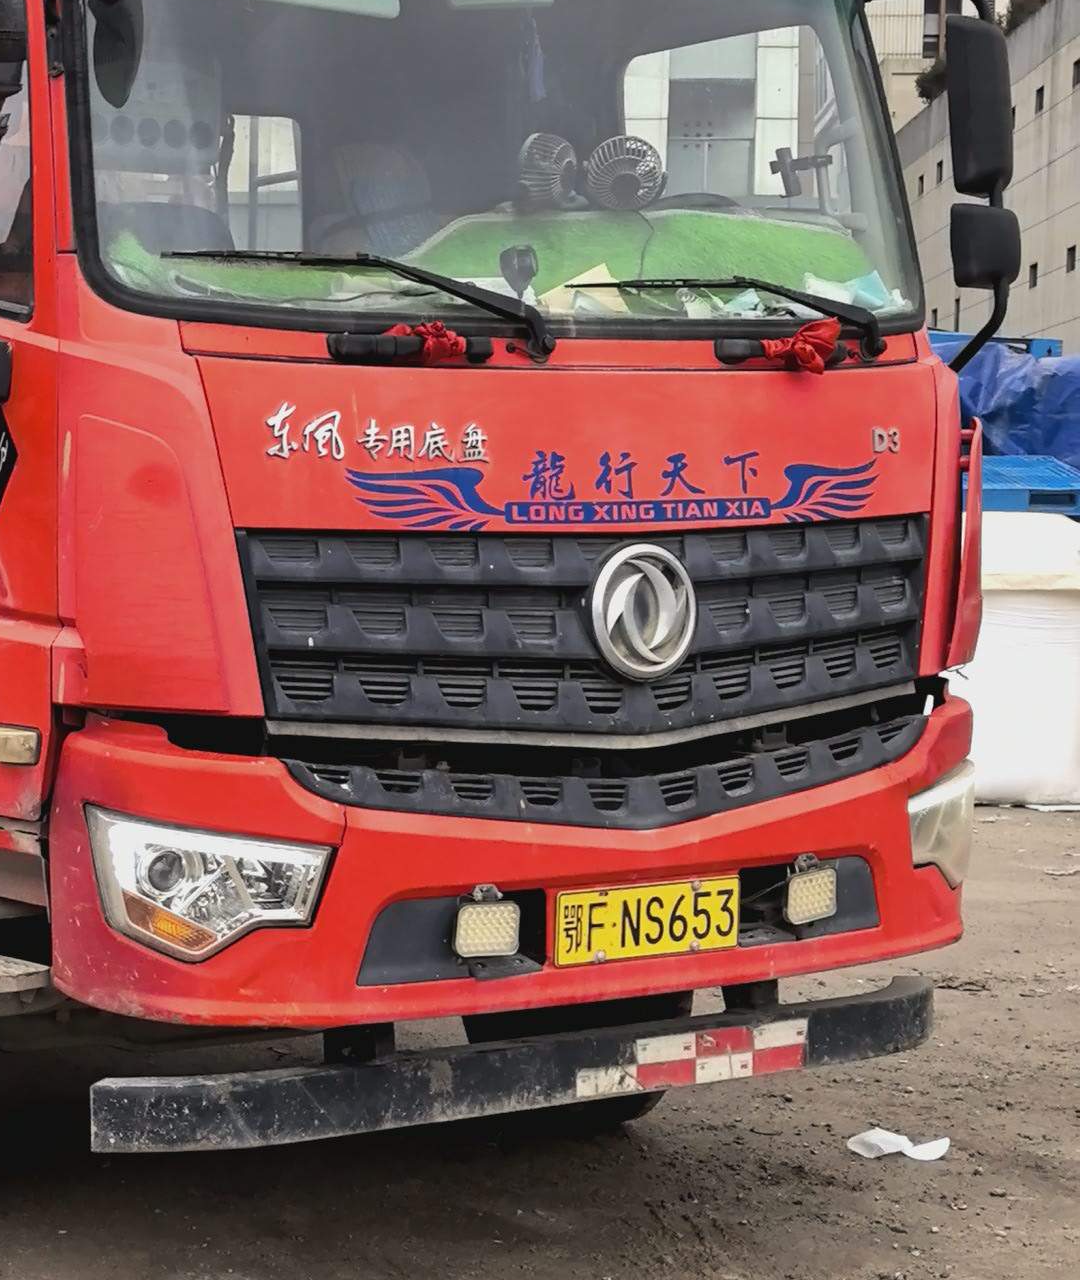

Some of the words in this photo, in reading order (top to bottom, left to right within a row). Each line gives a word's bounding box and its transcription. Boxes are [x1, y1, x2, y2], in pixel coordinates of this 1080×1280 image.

[357, 418, 489, 463] 专用底盘
[872, 425, 901, 454] D3
[512, 504, 584, 521] LONG
[593, 504, 655, 521] XING
[663, 501, 718, 519] TIAN
[725, 500, 766, 518] XIA
